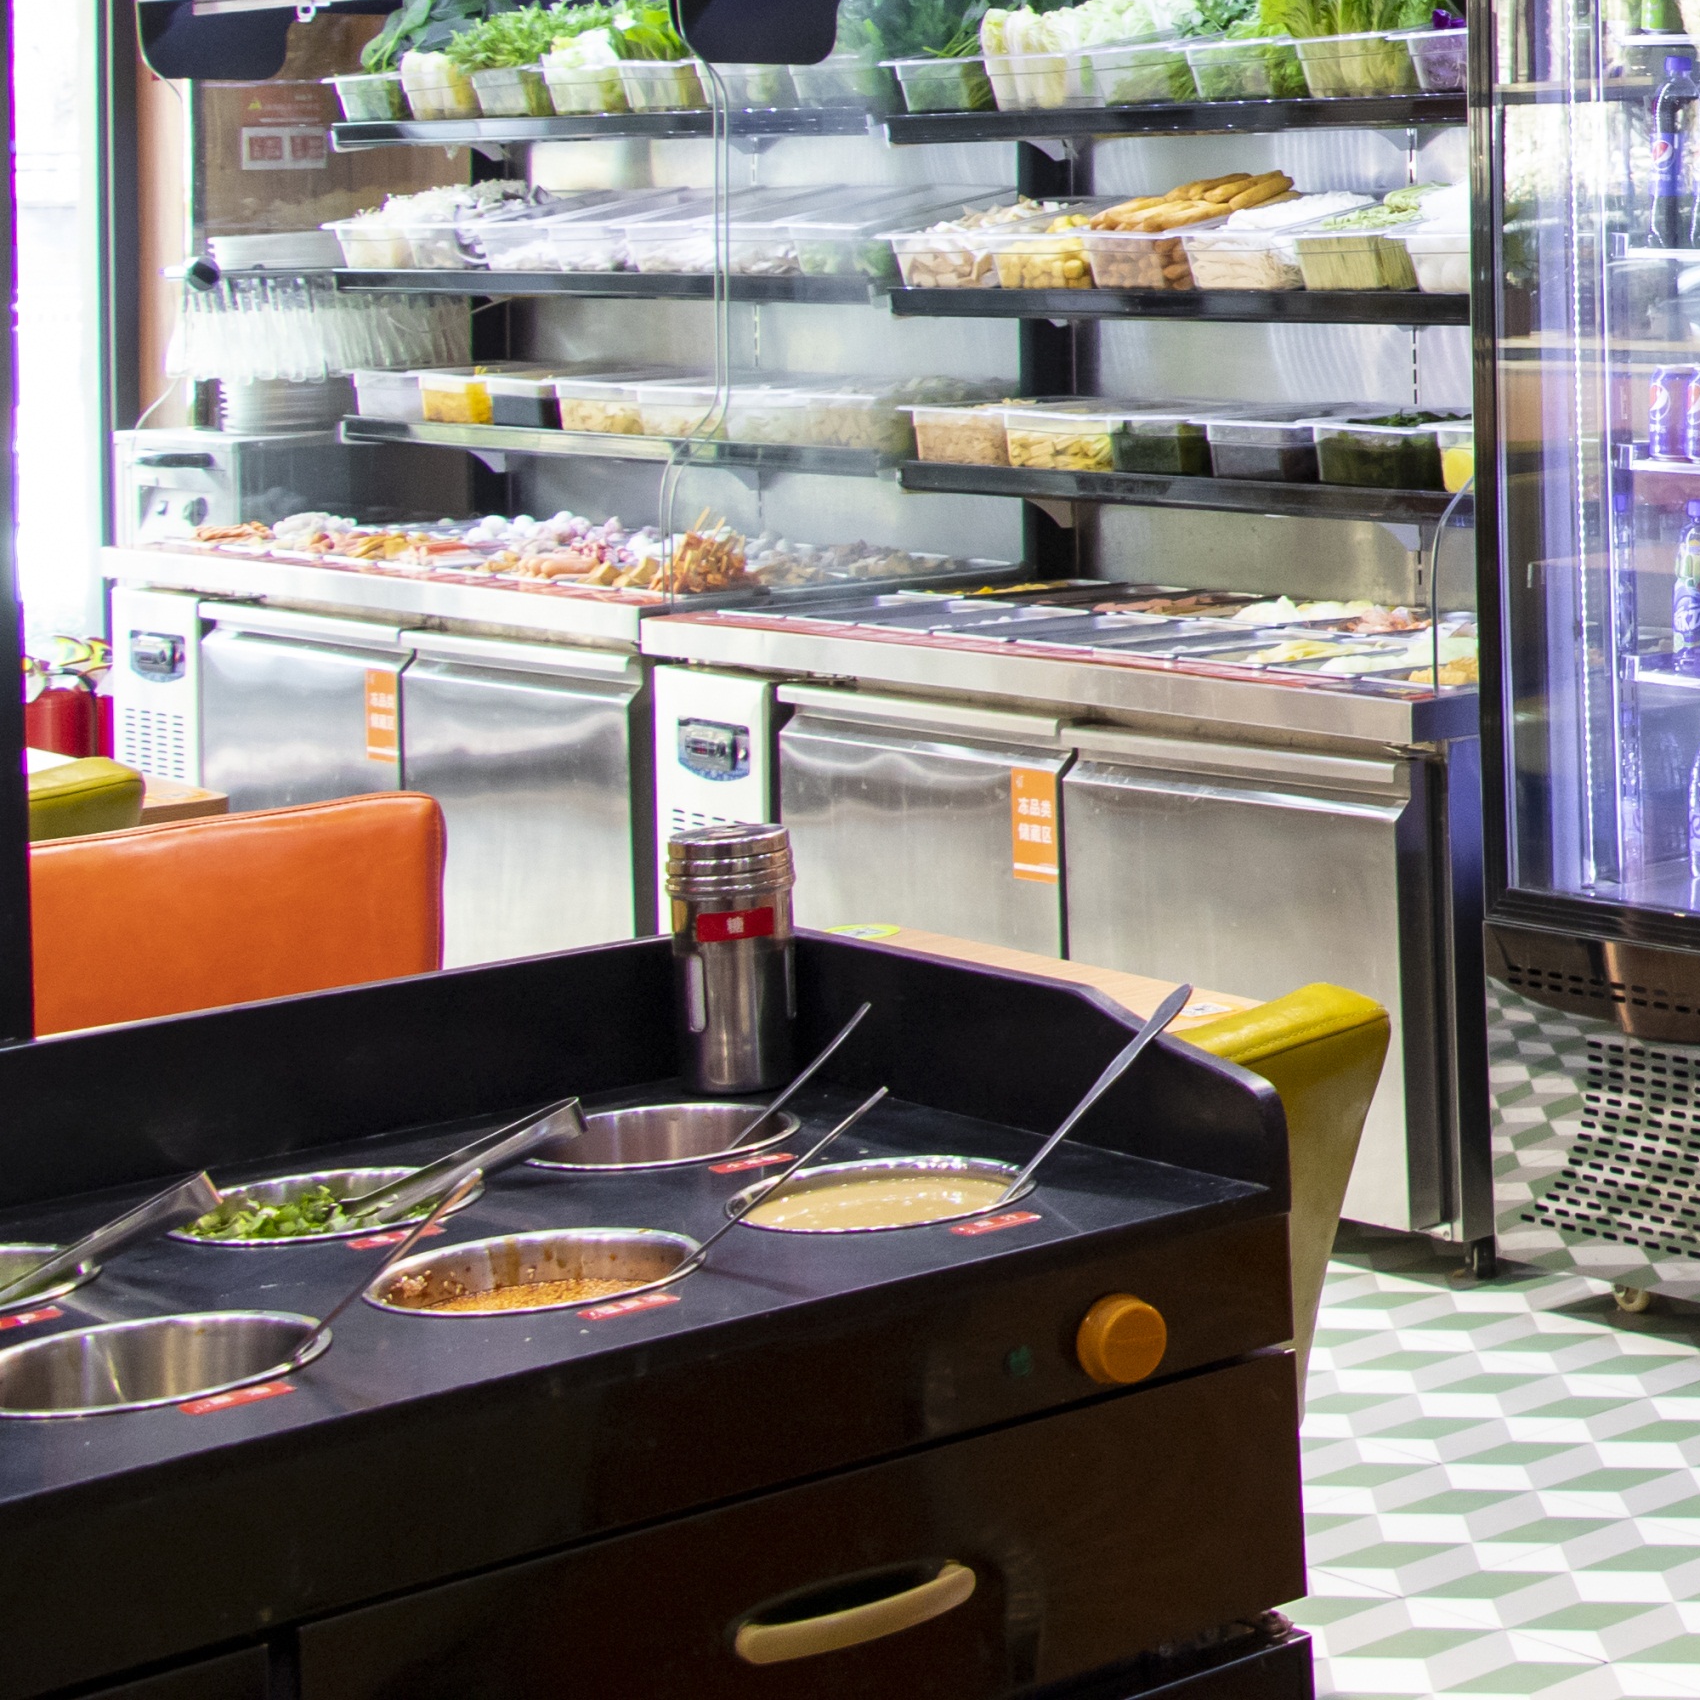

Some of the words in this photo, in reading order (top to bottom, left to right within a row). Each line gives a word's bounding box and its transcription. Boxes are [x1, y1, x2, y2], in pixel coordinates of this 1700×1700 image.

[1018, 796, 1052, 819] 冻品类
[1018, 822, 1052, 845] 储藏区
